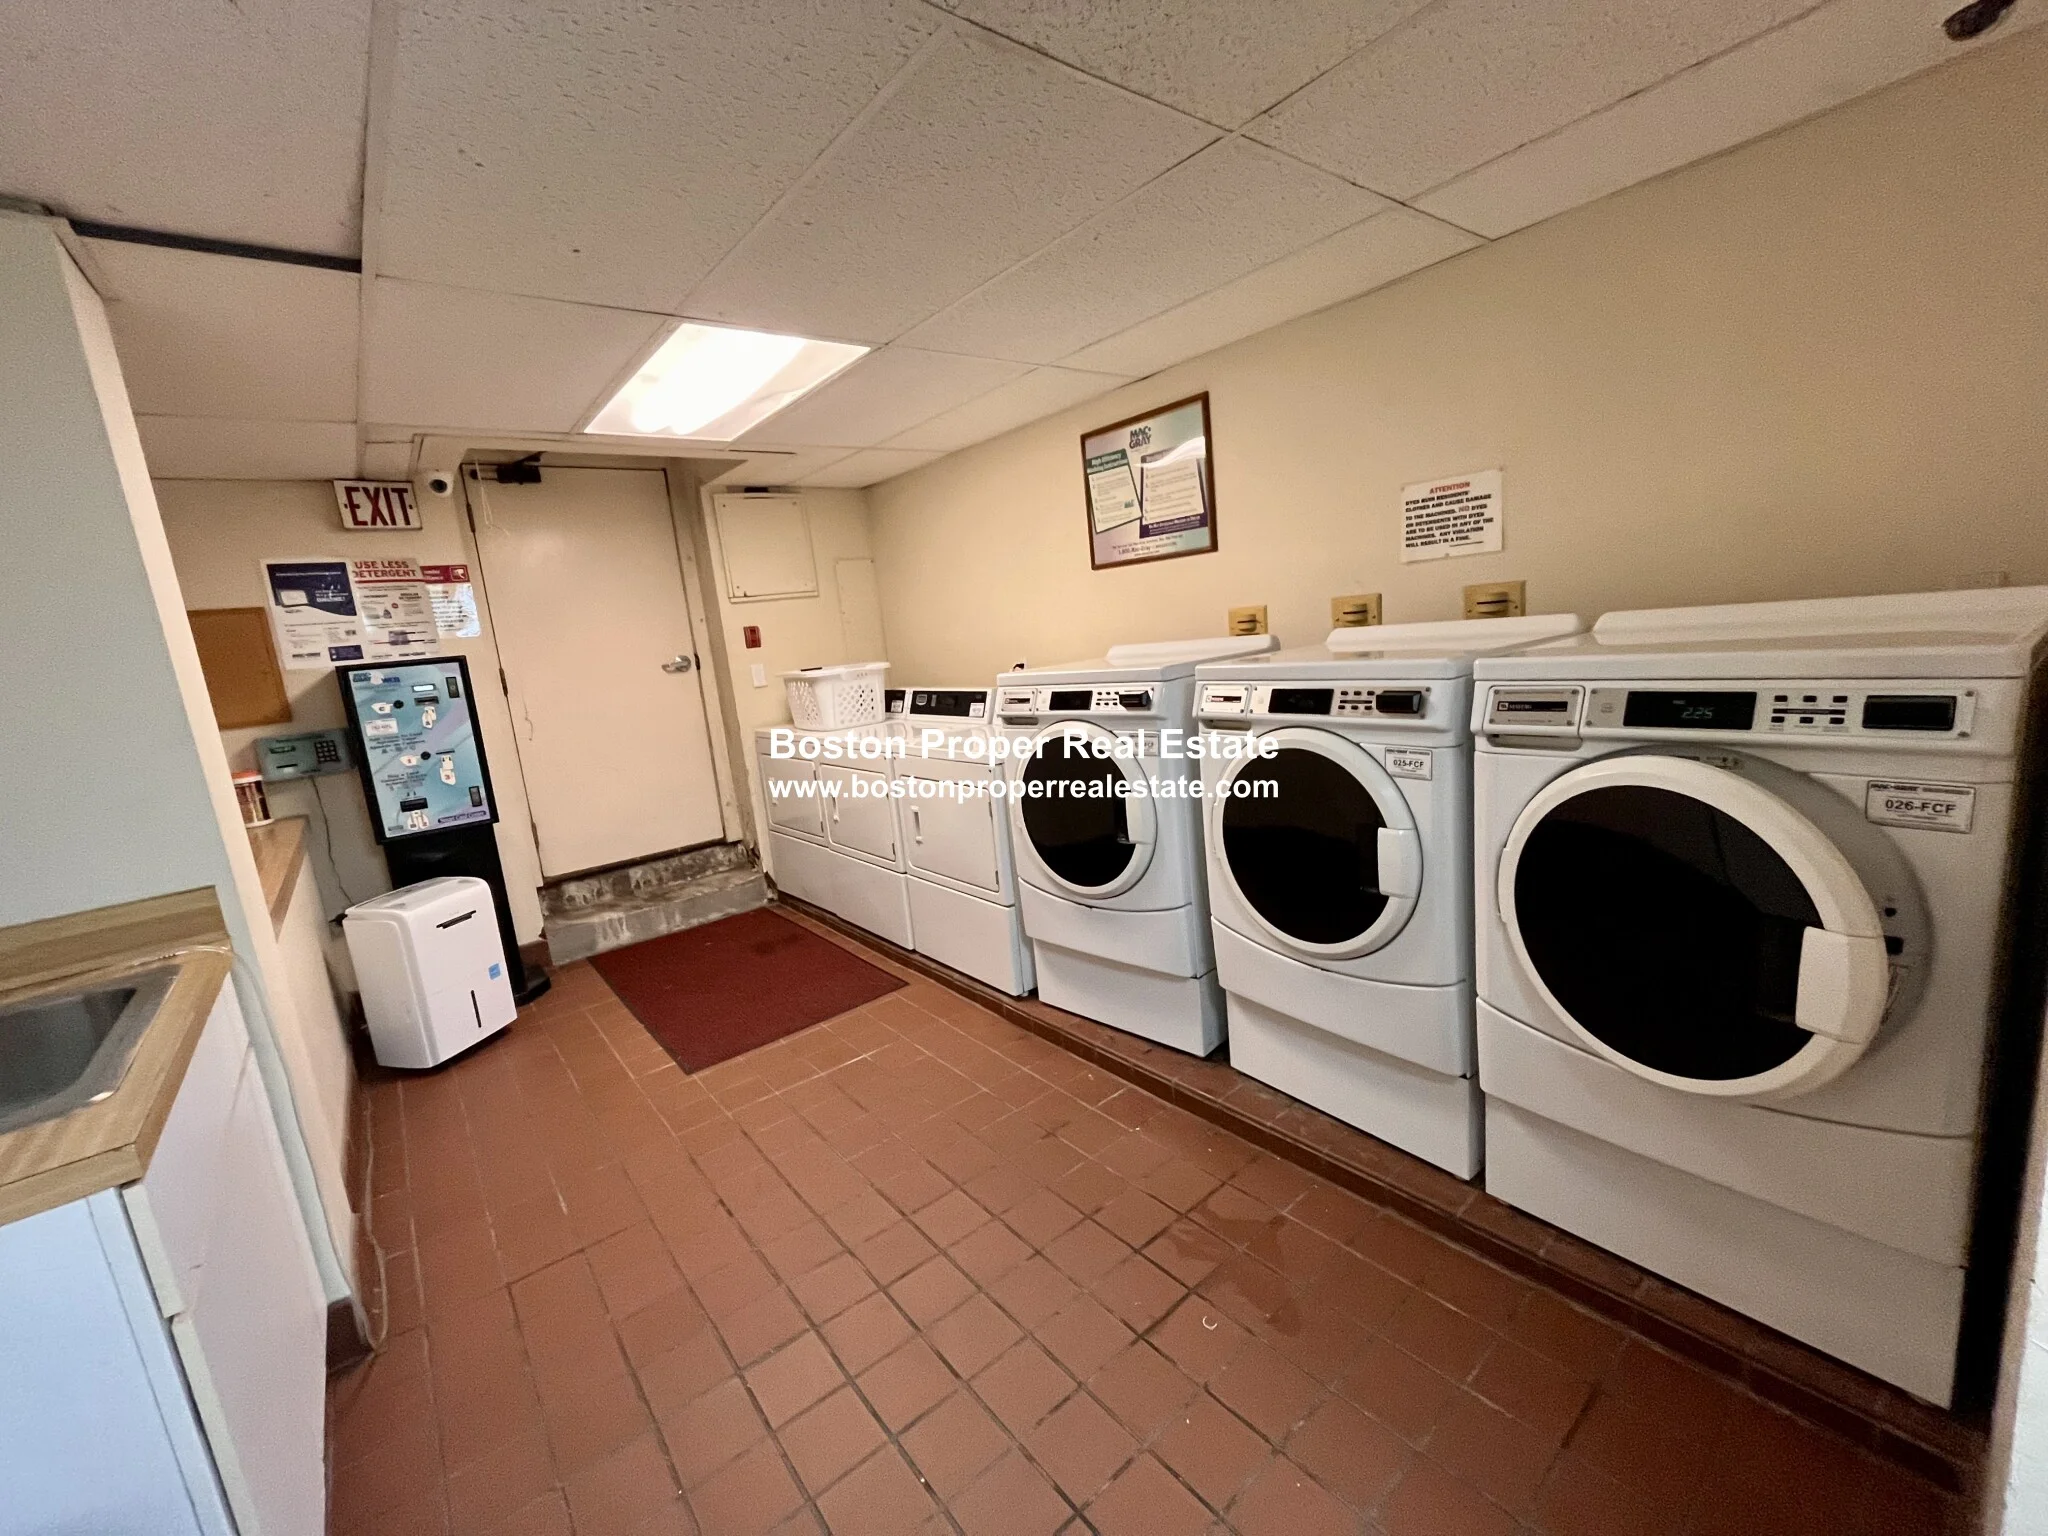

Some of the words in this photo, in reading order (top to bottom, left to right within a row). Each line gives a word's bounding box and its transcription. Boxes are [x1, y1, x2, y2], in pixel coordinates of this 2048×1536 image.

[1130, 434, 1151, 449] GRAY
[1430, 482, 1470, 494] ATTENTION
[1466, 494, 1492, 502] DAMAGE
[344, 486, 411, 526] EXIT
[1453, 526, 1484, 535] VIOLATION
[354, 561, 379, 569] USE
[381, 560, 409, 568] LESS
[352, 569, 416, 578] DETERGENT
[1393, 760, 1424, 768] 025-FCF
[1885, 799, 1956, 814] 026-FCF
